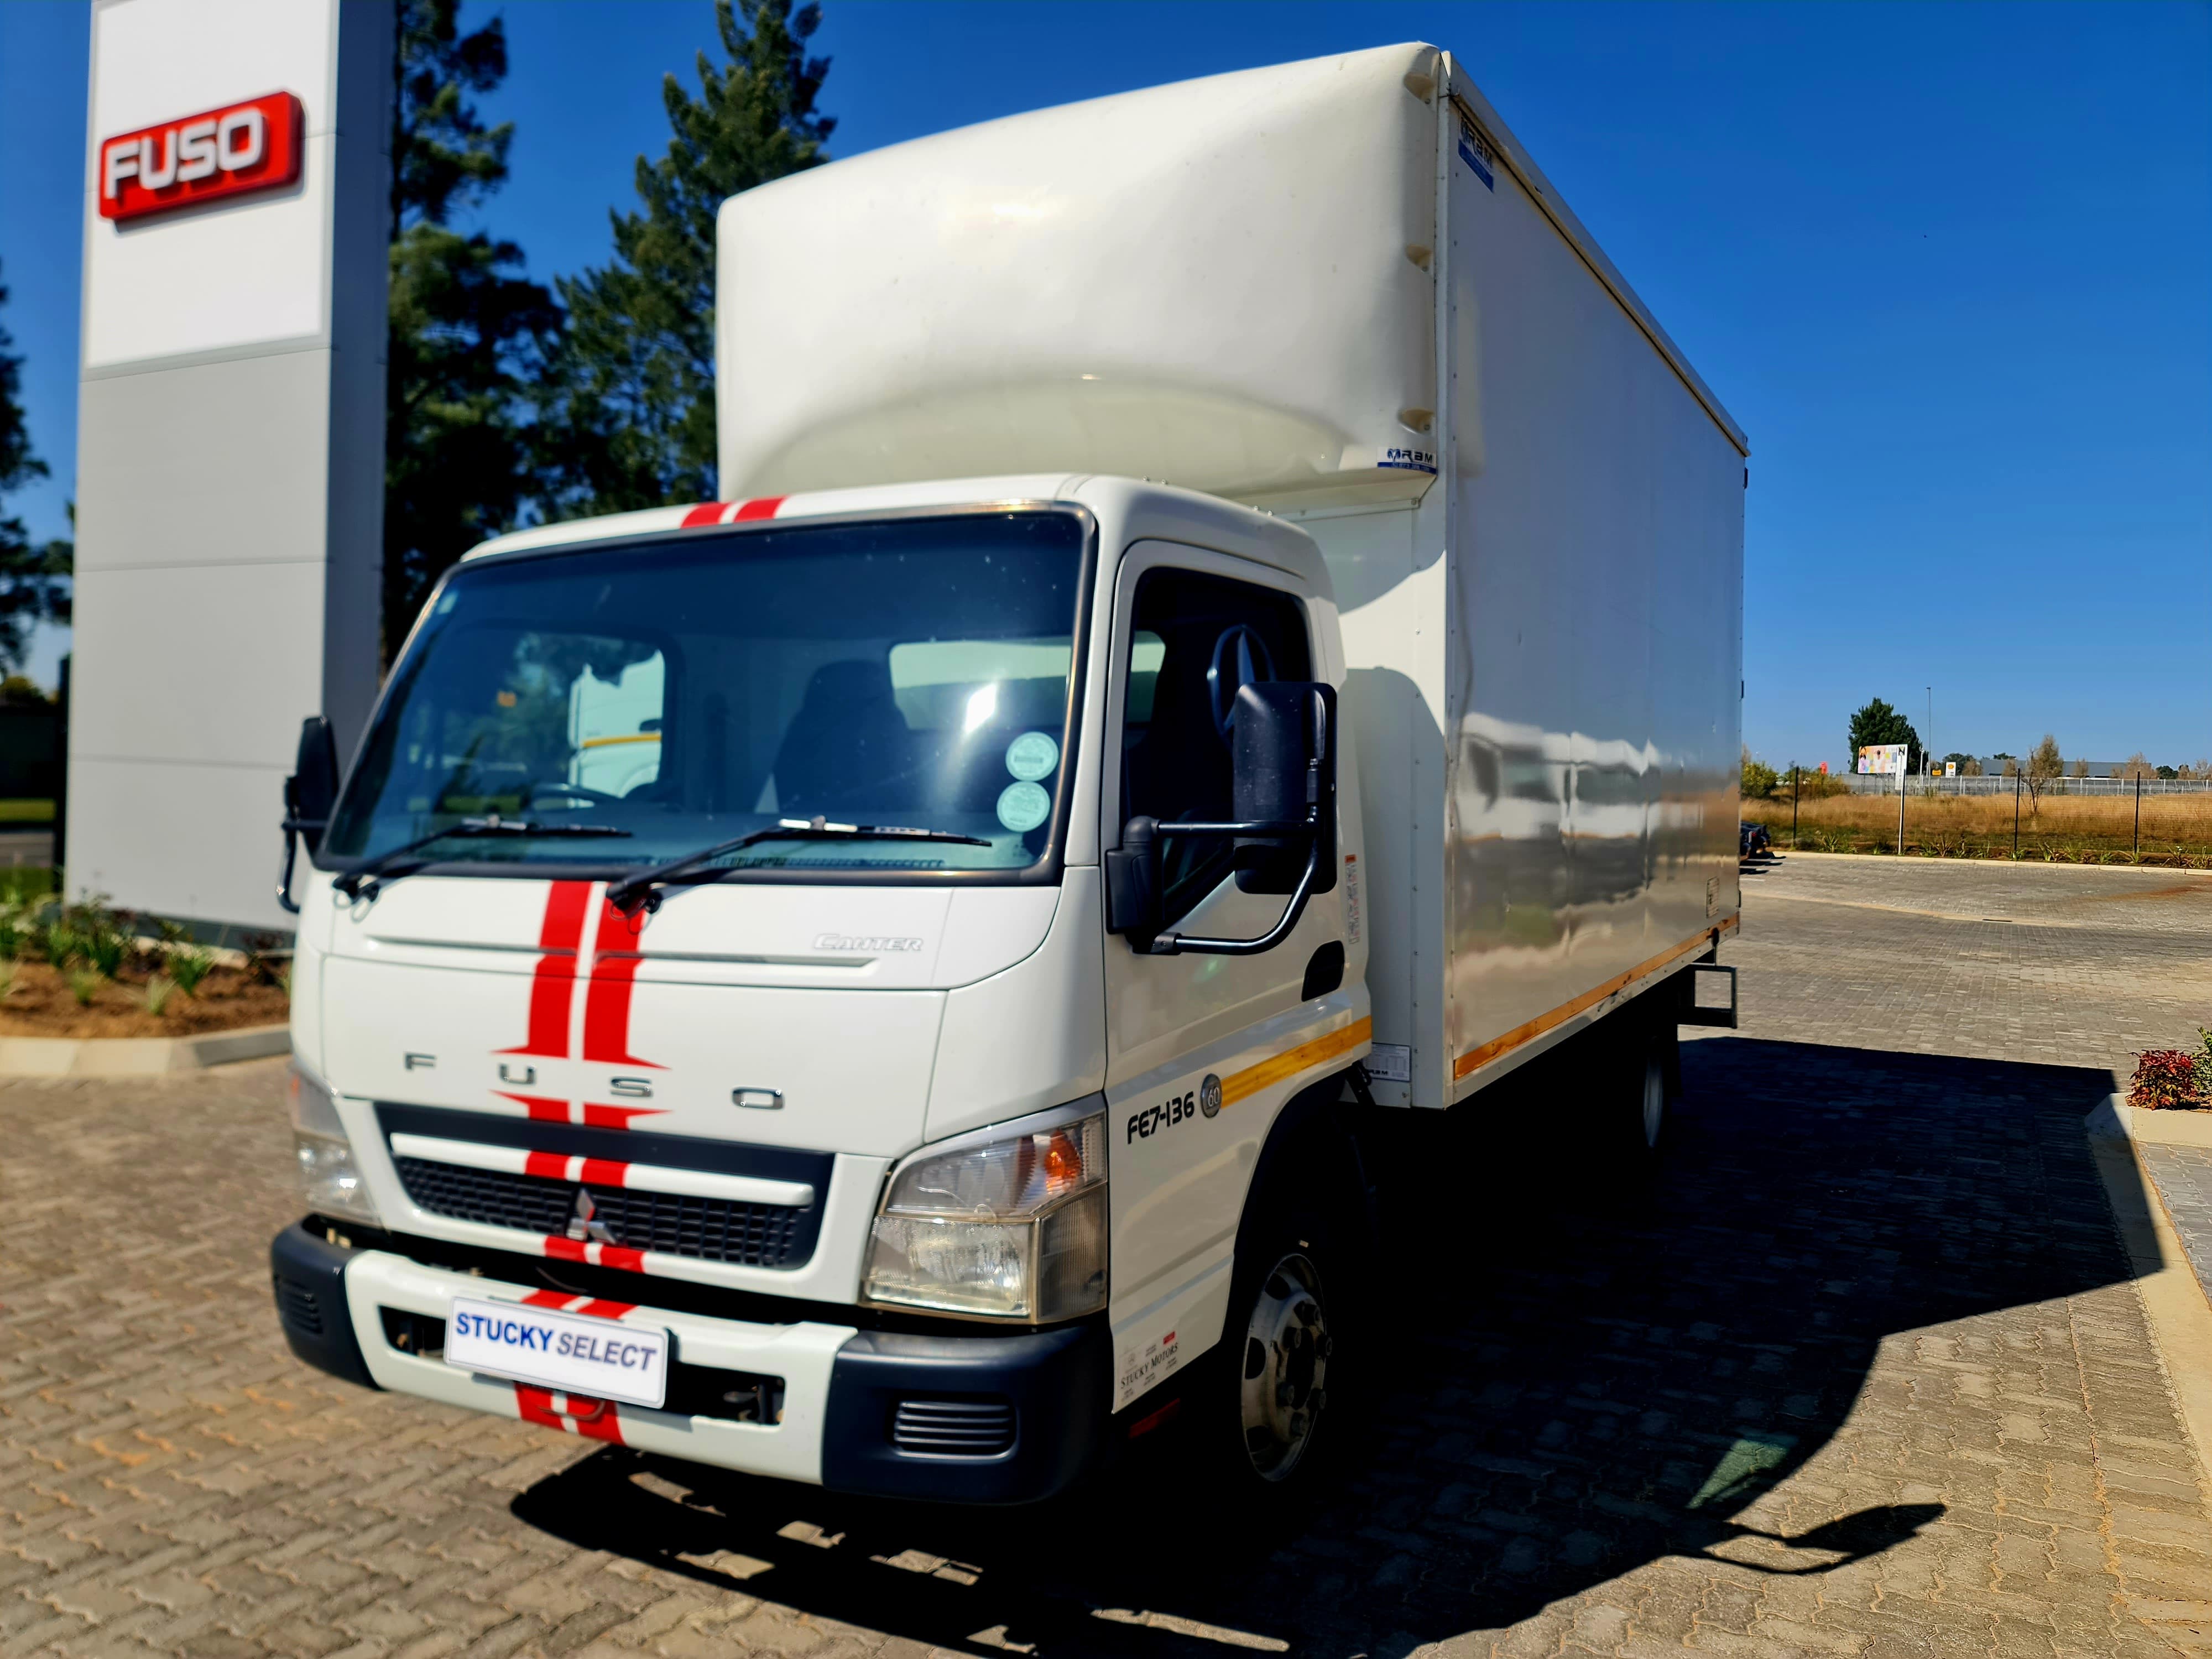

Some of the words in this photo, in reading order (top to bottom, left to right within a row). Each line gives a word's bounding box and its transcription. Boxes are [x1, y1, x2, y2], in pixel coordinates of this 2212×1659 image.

[106, 107, 263, 198] FUSO
[404, 1052, 785, 1110] FUSO
[1127, 1091, 1195, 1145] FE7-136
[456, 1312, 554, 1352] STUCKY
[556, 1331, 658, 1371] SELECT
[1120, 1362, 1149, 1389] STUCKY
[1151, 1342, 1178, 1369] MOTORS
